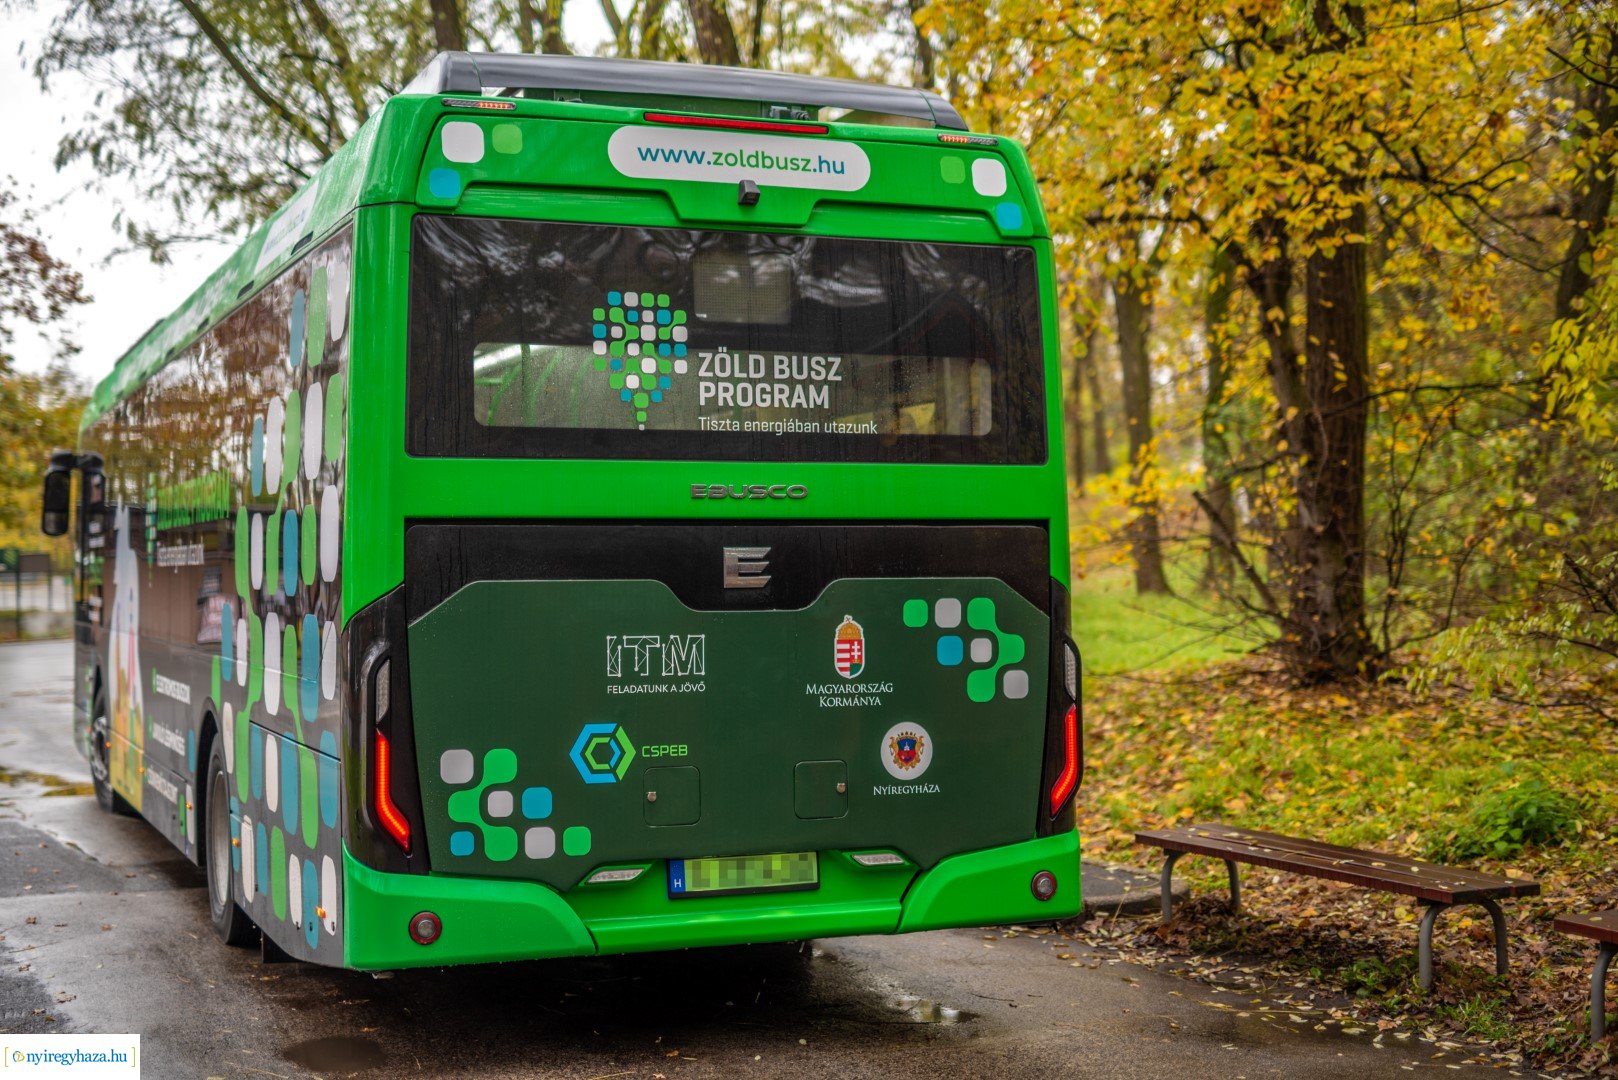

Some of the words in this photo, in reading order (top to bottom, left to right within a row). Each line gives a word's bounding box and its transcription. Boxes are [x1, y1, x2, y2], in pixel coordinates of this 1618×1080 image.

[637, 145, 846, 175] www.zoldbusz.hu
[698, 346, 765, 378] ZÖLD
[774, 354, 842, 381] BUSZ
[699, 382, 830, 409] PROGRAM
[698, 416, 740, 432] Tiszta
[744, 418, 820, 436] energiában
[824, 420, 878, 435] utazunk
[690, 483, 809, 500] EBUSCO
[606, 633, 706, 678] ITM
[606, 684, 668, 695] FELADATUNK
[668, 684, 678, 694] A
[679, 681, 706, 694] JÖVŐ
[641, 744, 688, 758] CSPEB
[873, 783, 941, 796] NYÍREGYHÁZA
[673, 878, 682, 889] H
